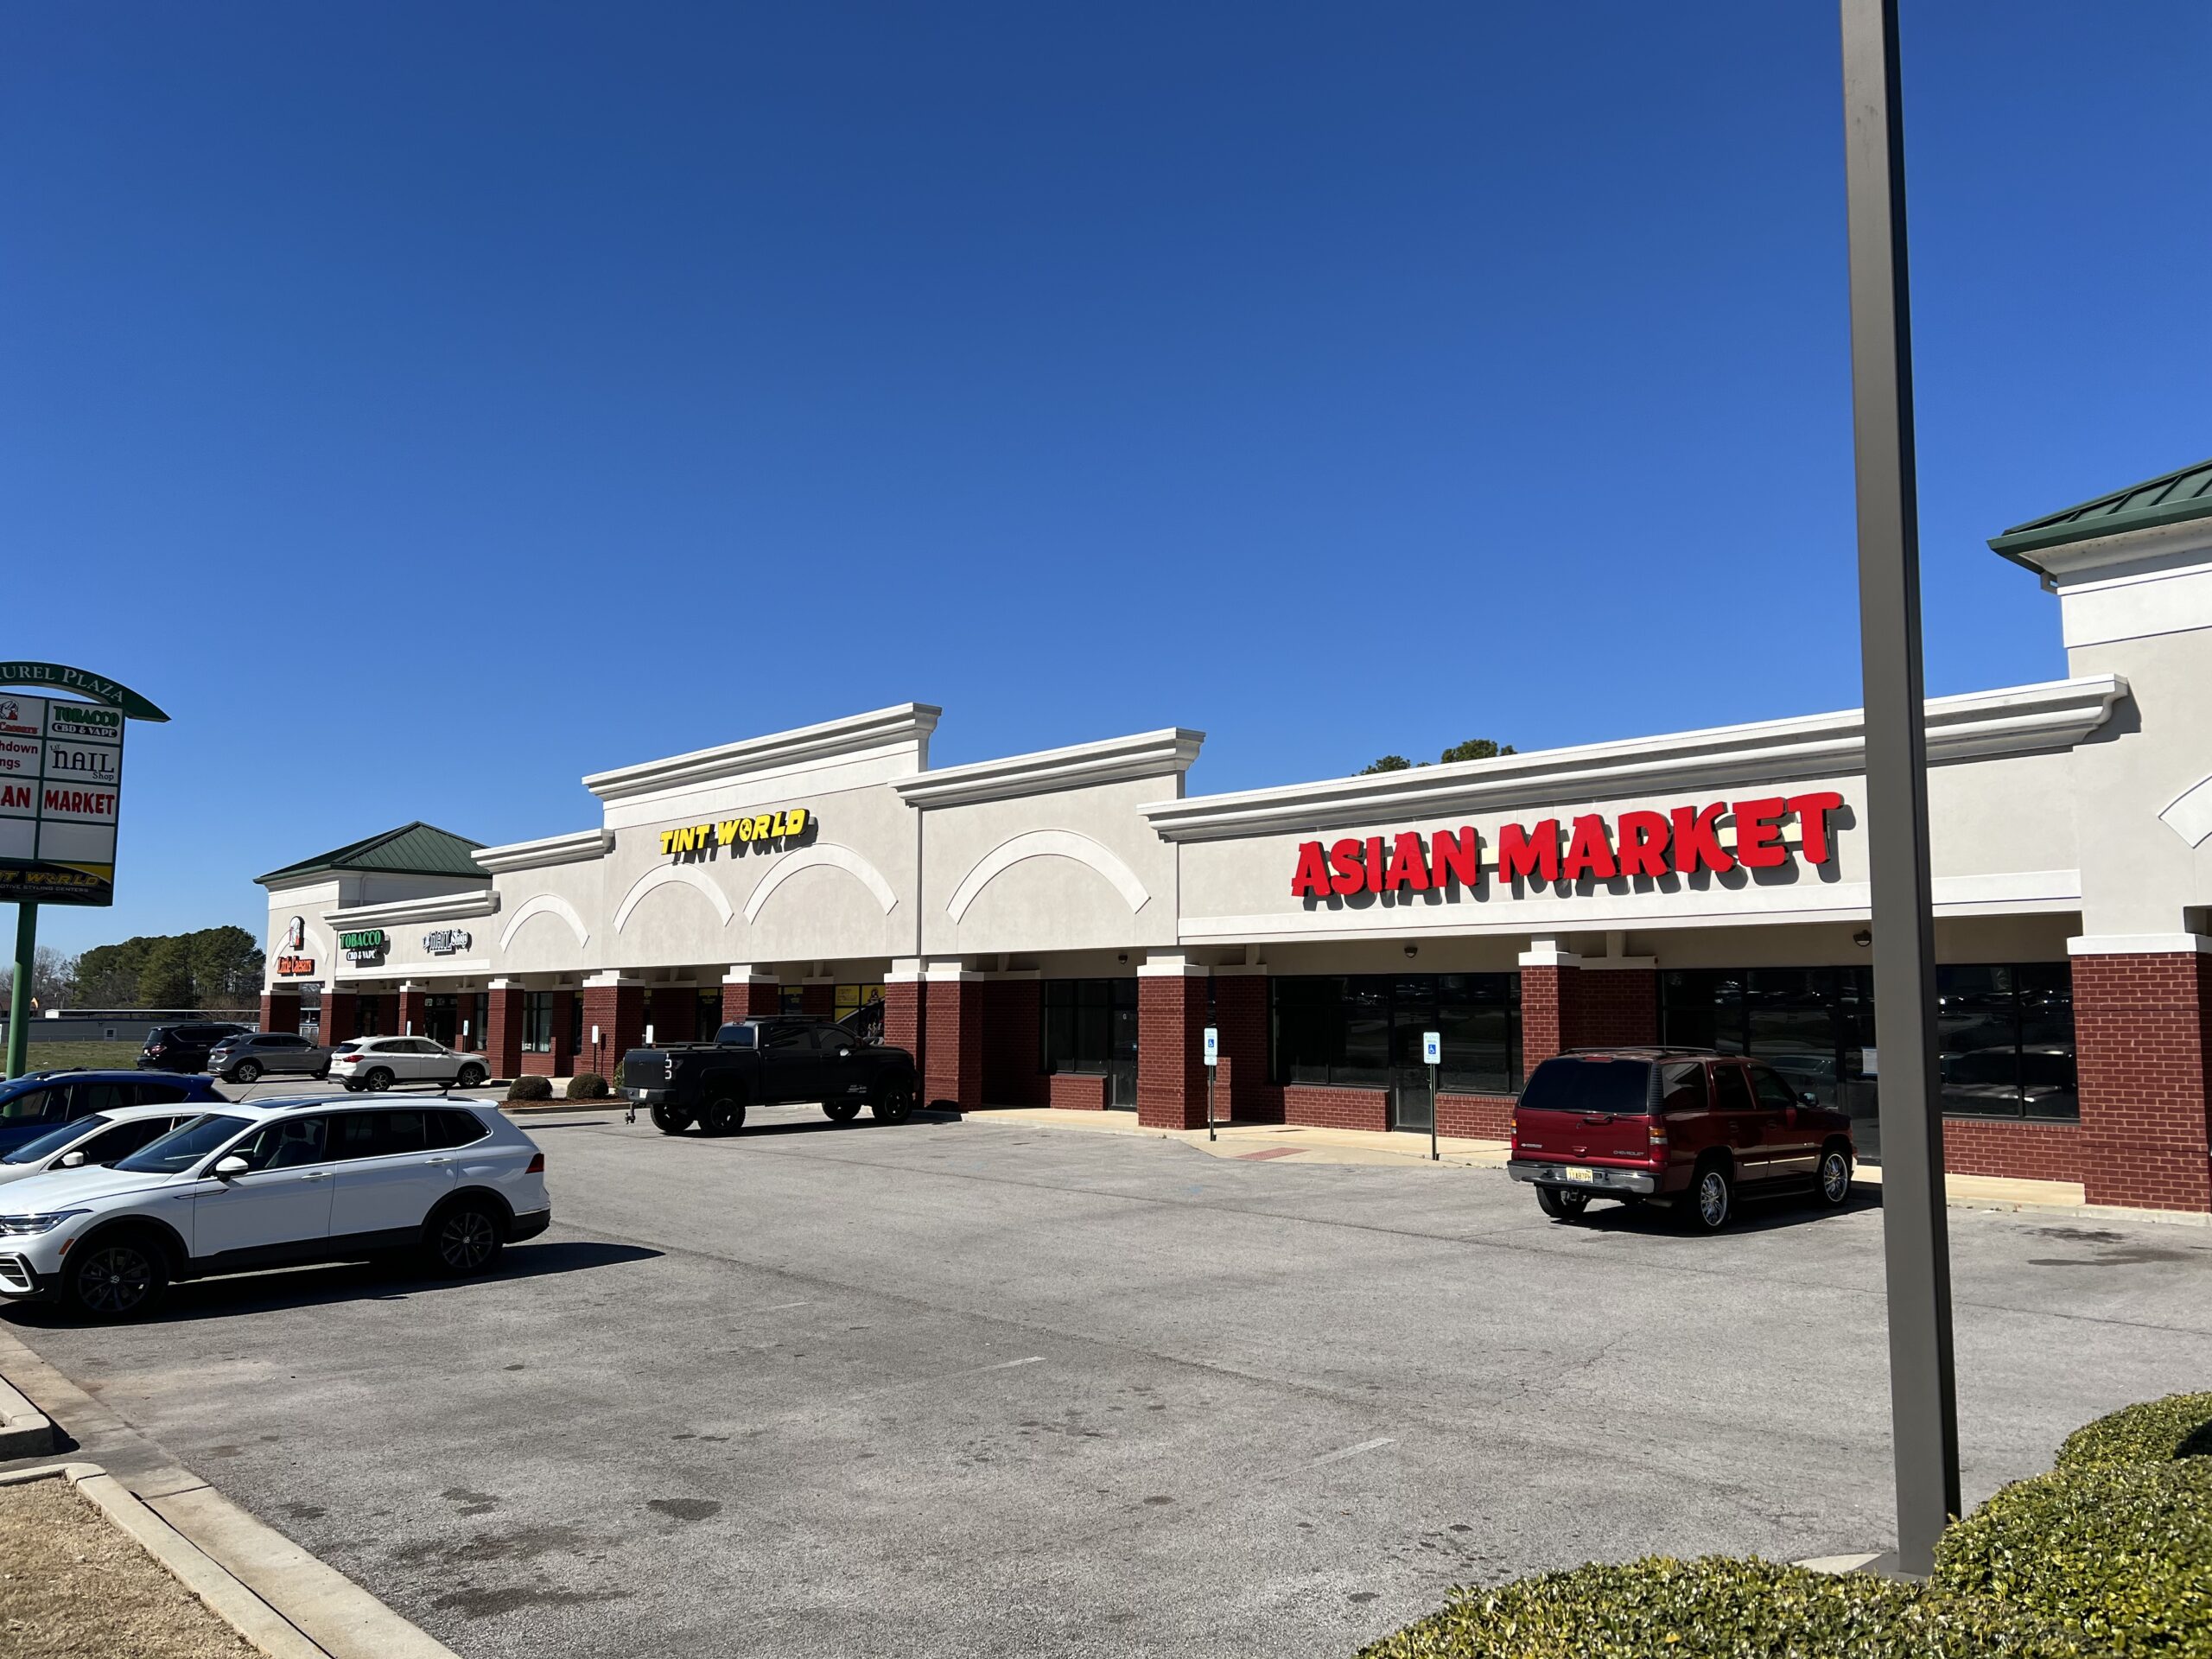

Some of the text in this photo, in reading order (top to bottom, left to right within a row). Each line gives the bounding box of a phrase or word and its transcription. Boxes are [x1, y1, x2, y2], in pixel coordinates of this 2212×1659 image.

[0, 665, 123, 702] UREL PLAZA
[54, 706, 120, 727] TOBACCO
[54, 724, 77, 734] CBD
[88, 727, 116, 737] VAPE
[92, 771, 114, 781] Shop
[0, 785, 31, 809] AN
[44, 790, 115, 815] MARKET
[660, 809, 808, 855] TINT WORLD
[1291, 791, 1842, 897] ASIAN MARKET
[25, 871, 100, 887] WORLD
[340, 931, 381, 949] TOBACCO
[347, 950, 358, 960] CBD
[362, 950, 376, 959] VAPE
